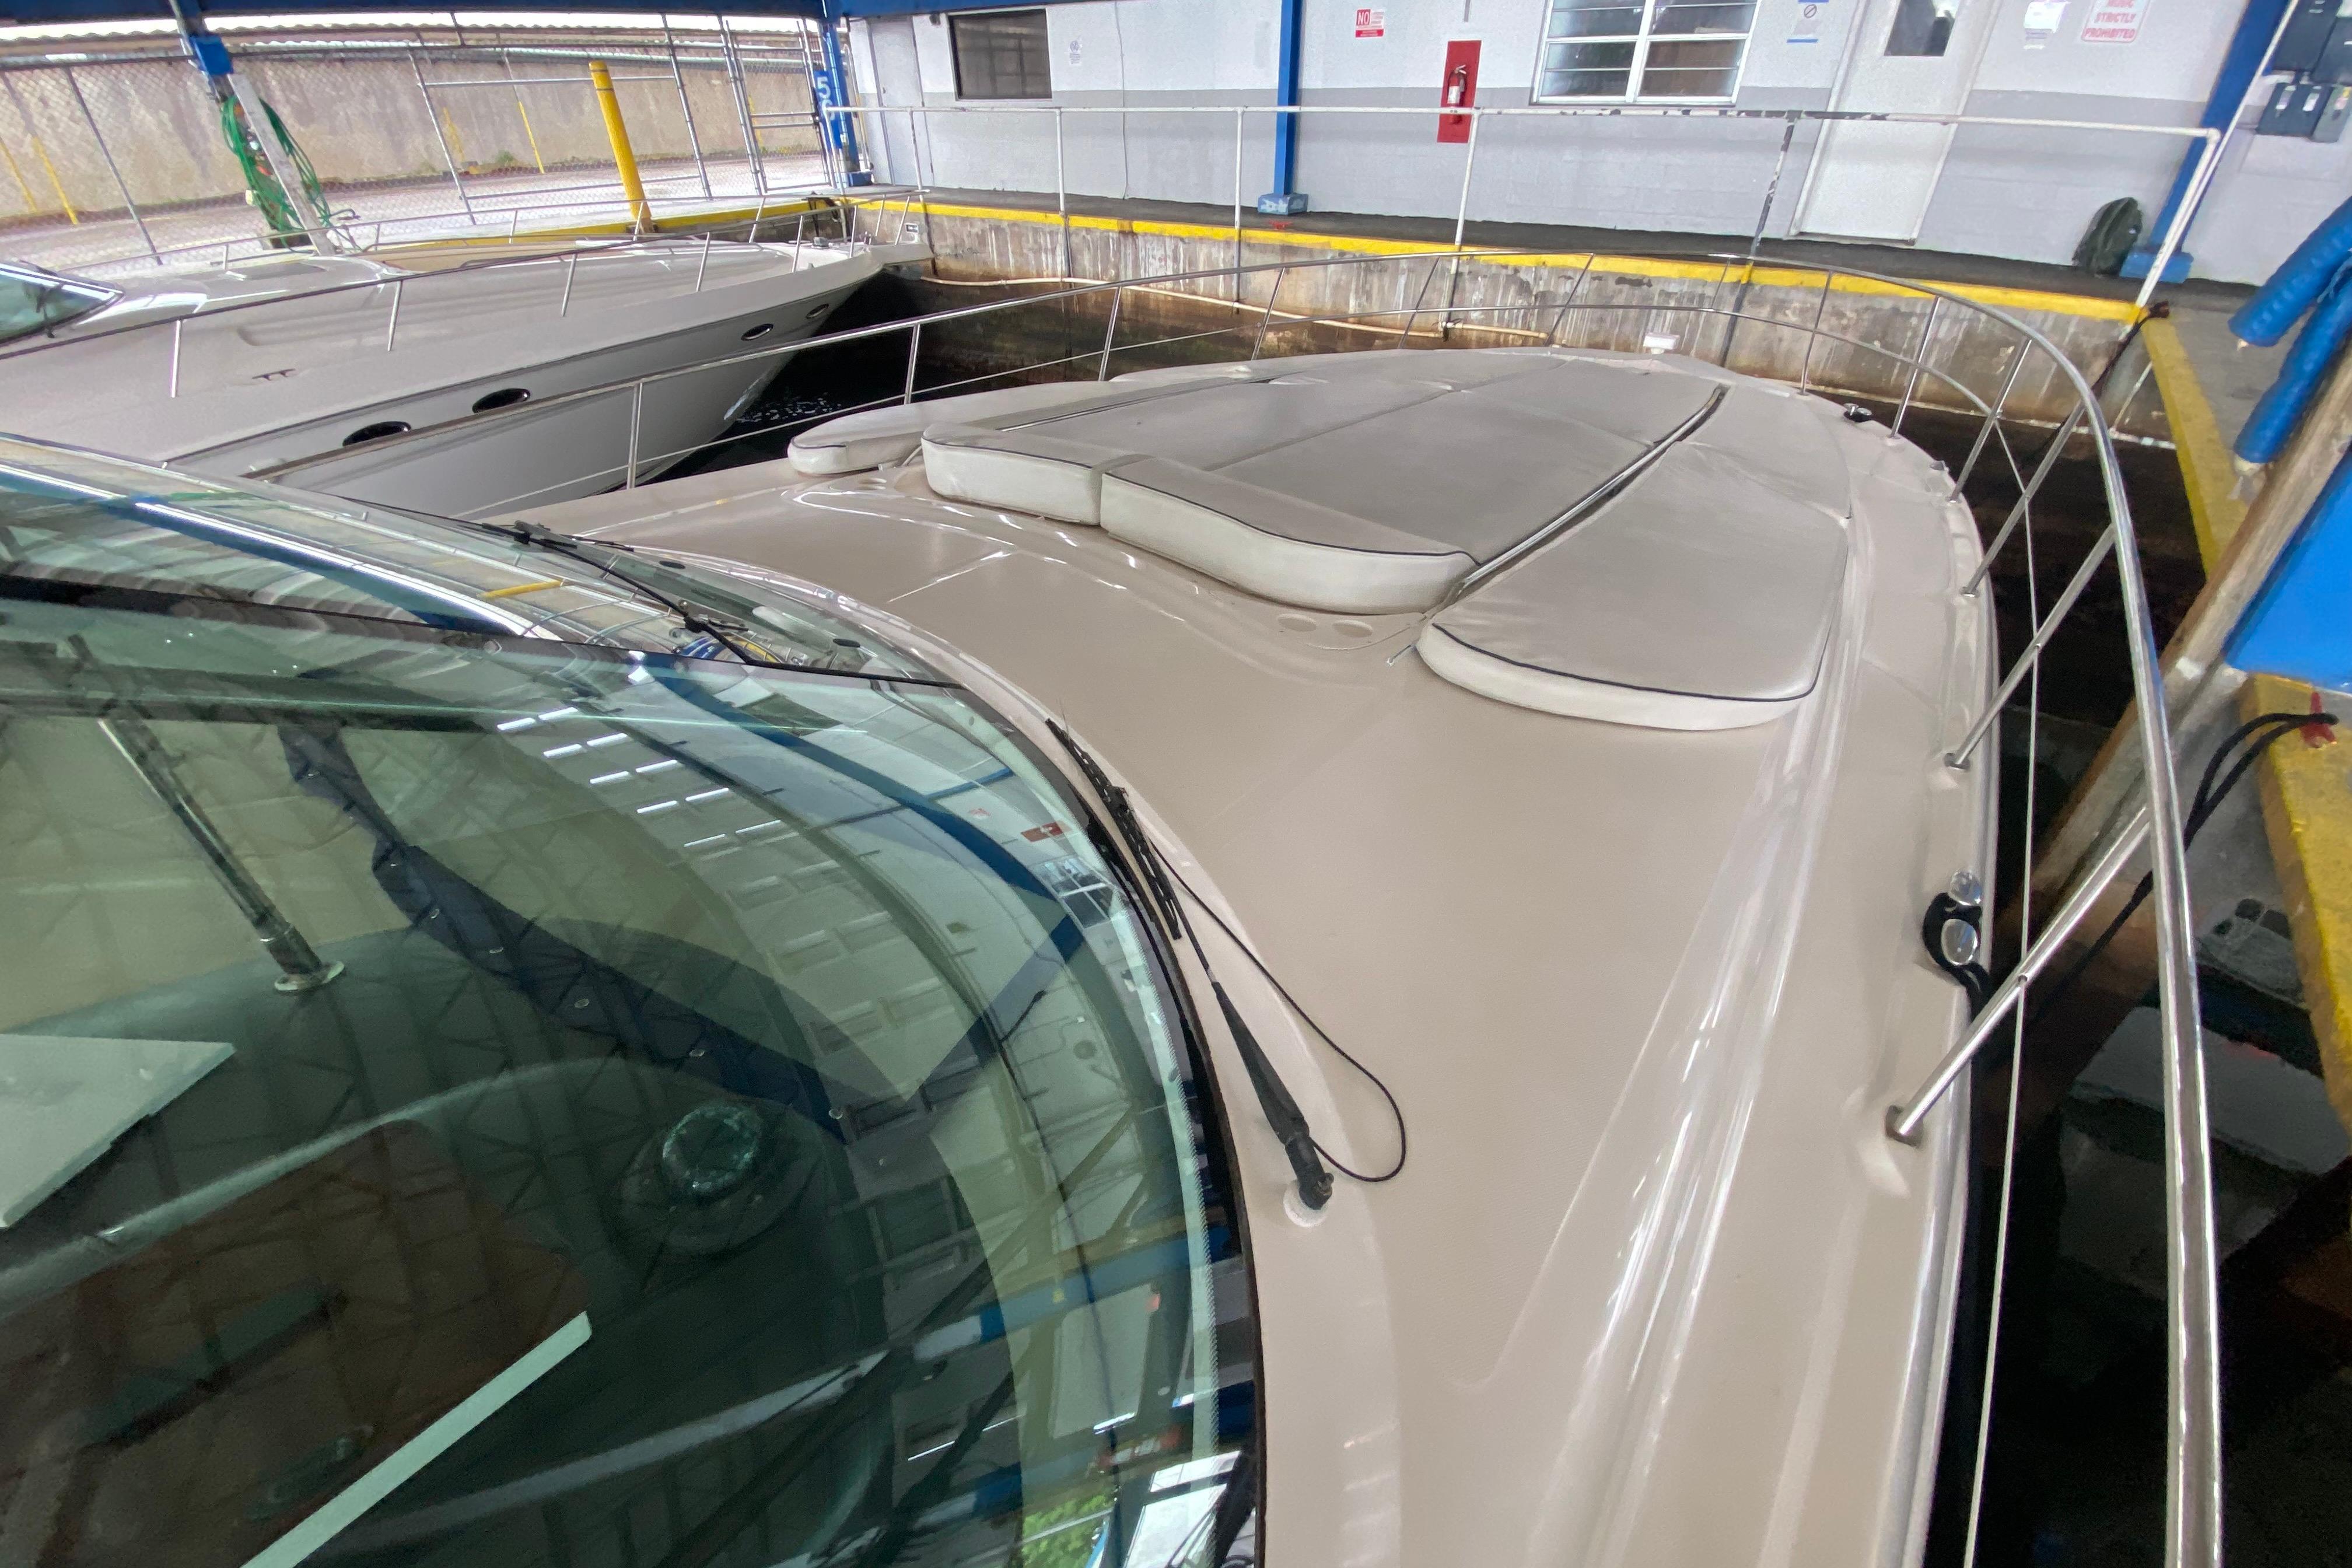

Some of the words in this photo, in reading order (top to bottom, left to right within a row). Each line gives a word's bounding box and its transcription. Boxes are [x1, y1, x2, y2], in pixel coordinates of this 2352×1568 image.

[1357, 12, 1370, 25] NO
[2094, 12, 2136, 23] STRICTLY
[2084, 27, 2136, 38] PROHIBITED
